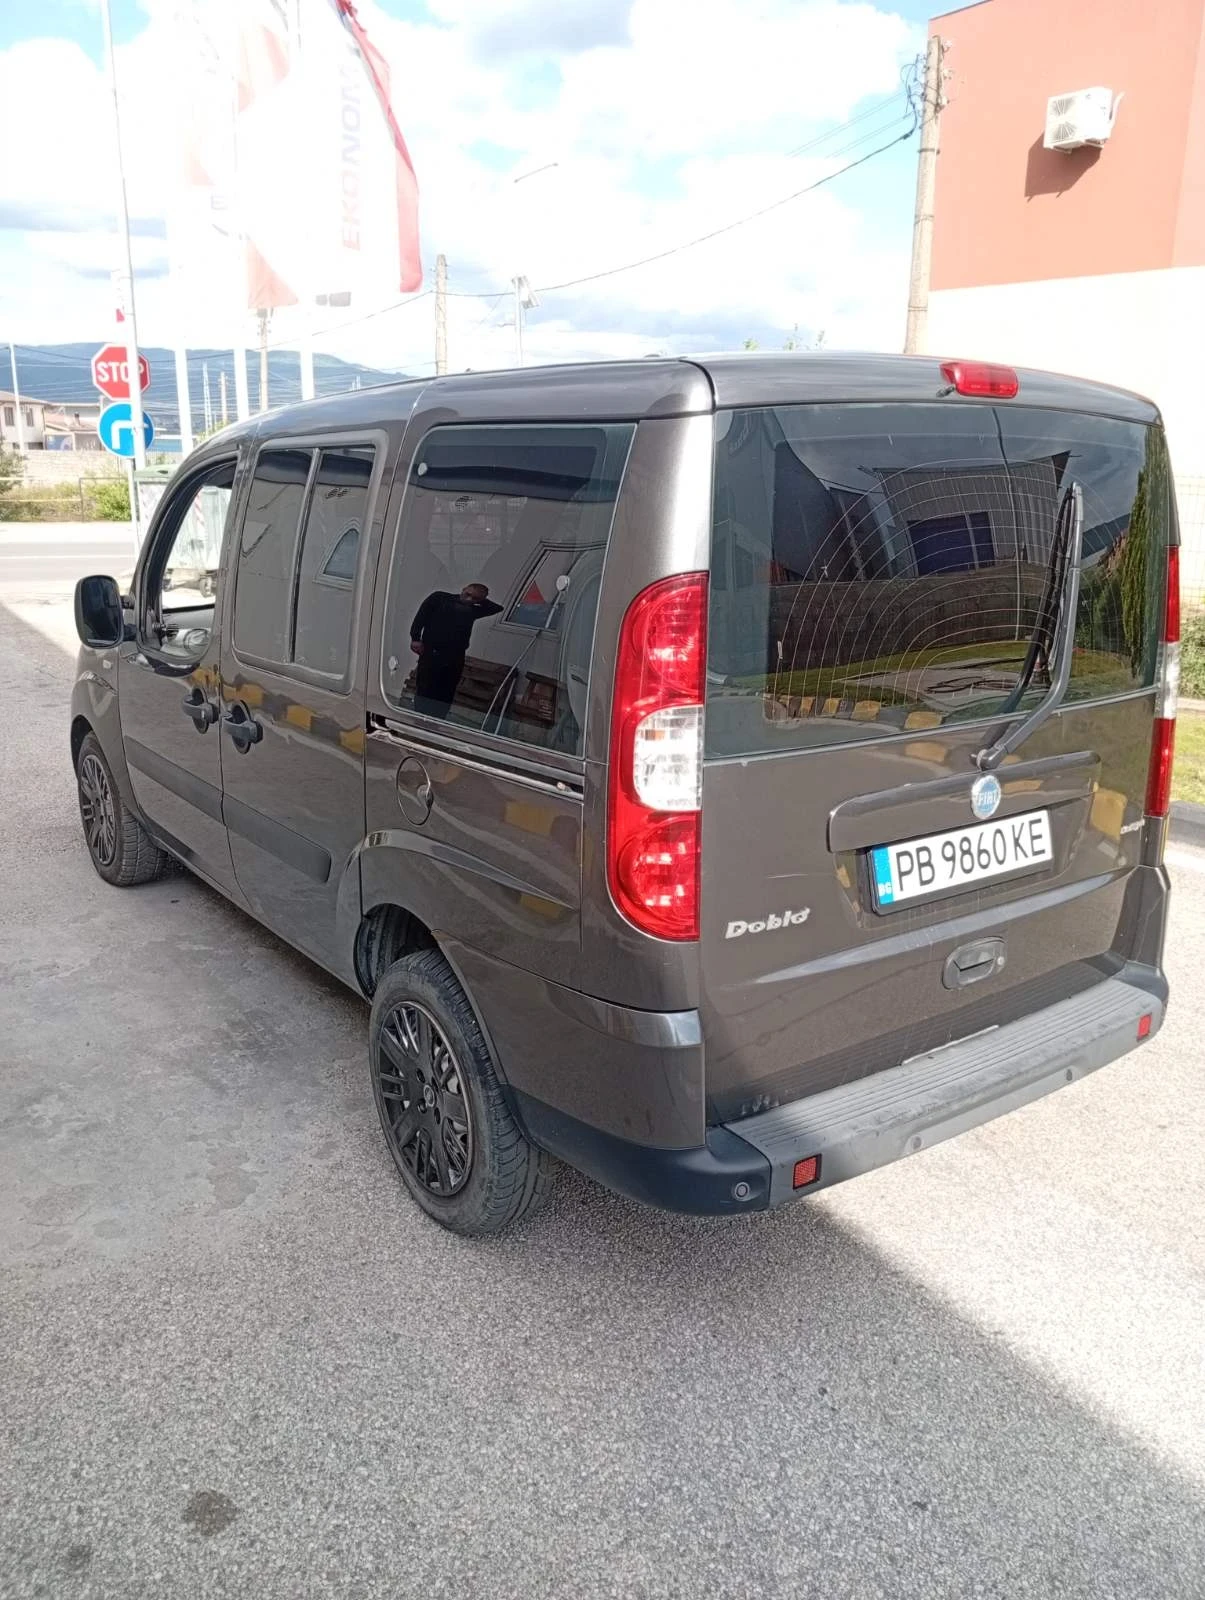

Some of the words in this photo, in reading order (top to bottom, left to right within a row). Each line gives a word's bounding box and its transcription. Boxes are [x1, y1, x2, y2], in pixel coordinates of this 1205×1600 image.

[895, 845, 936, 892] PB
[941, 827, 1007, 880] 9860
[1011, 817, 1046, 862] KE
